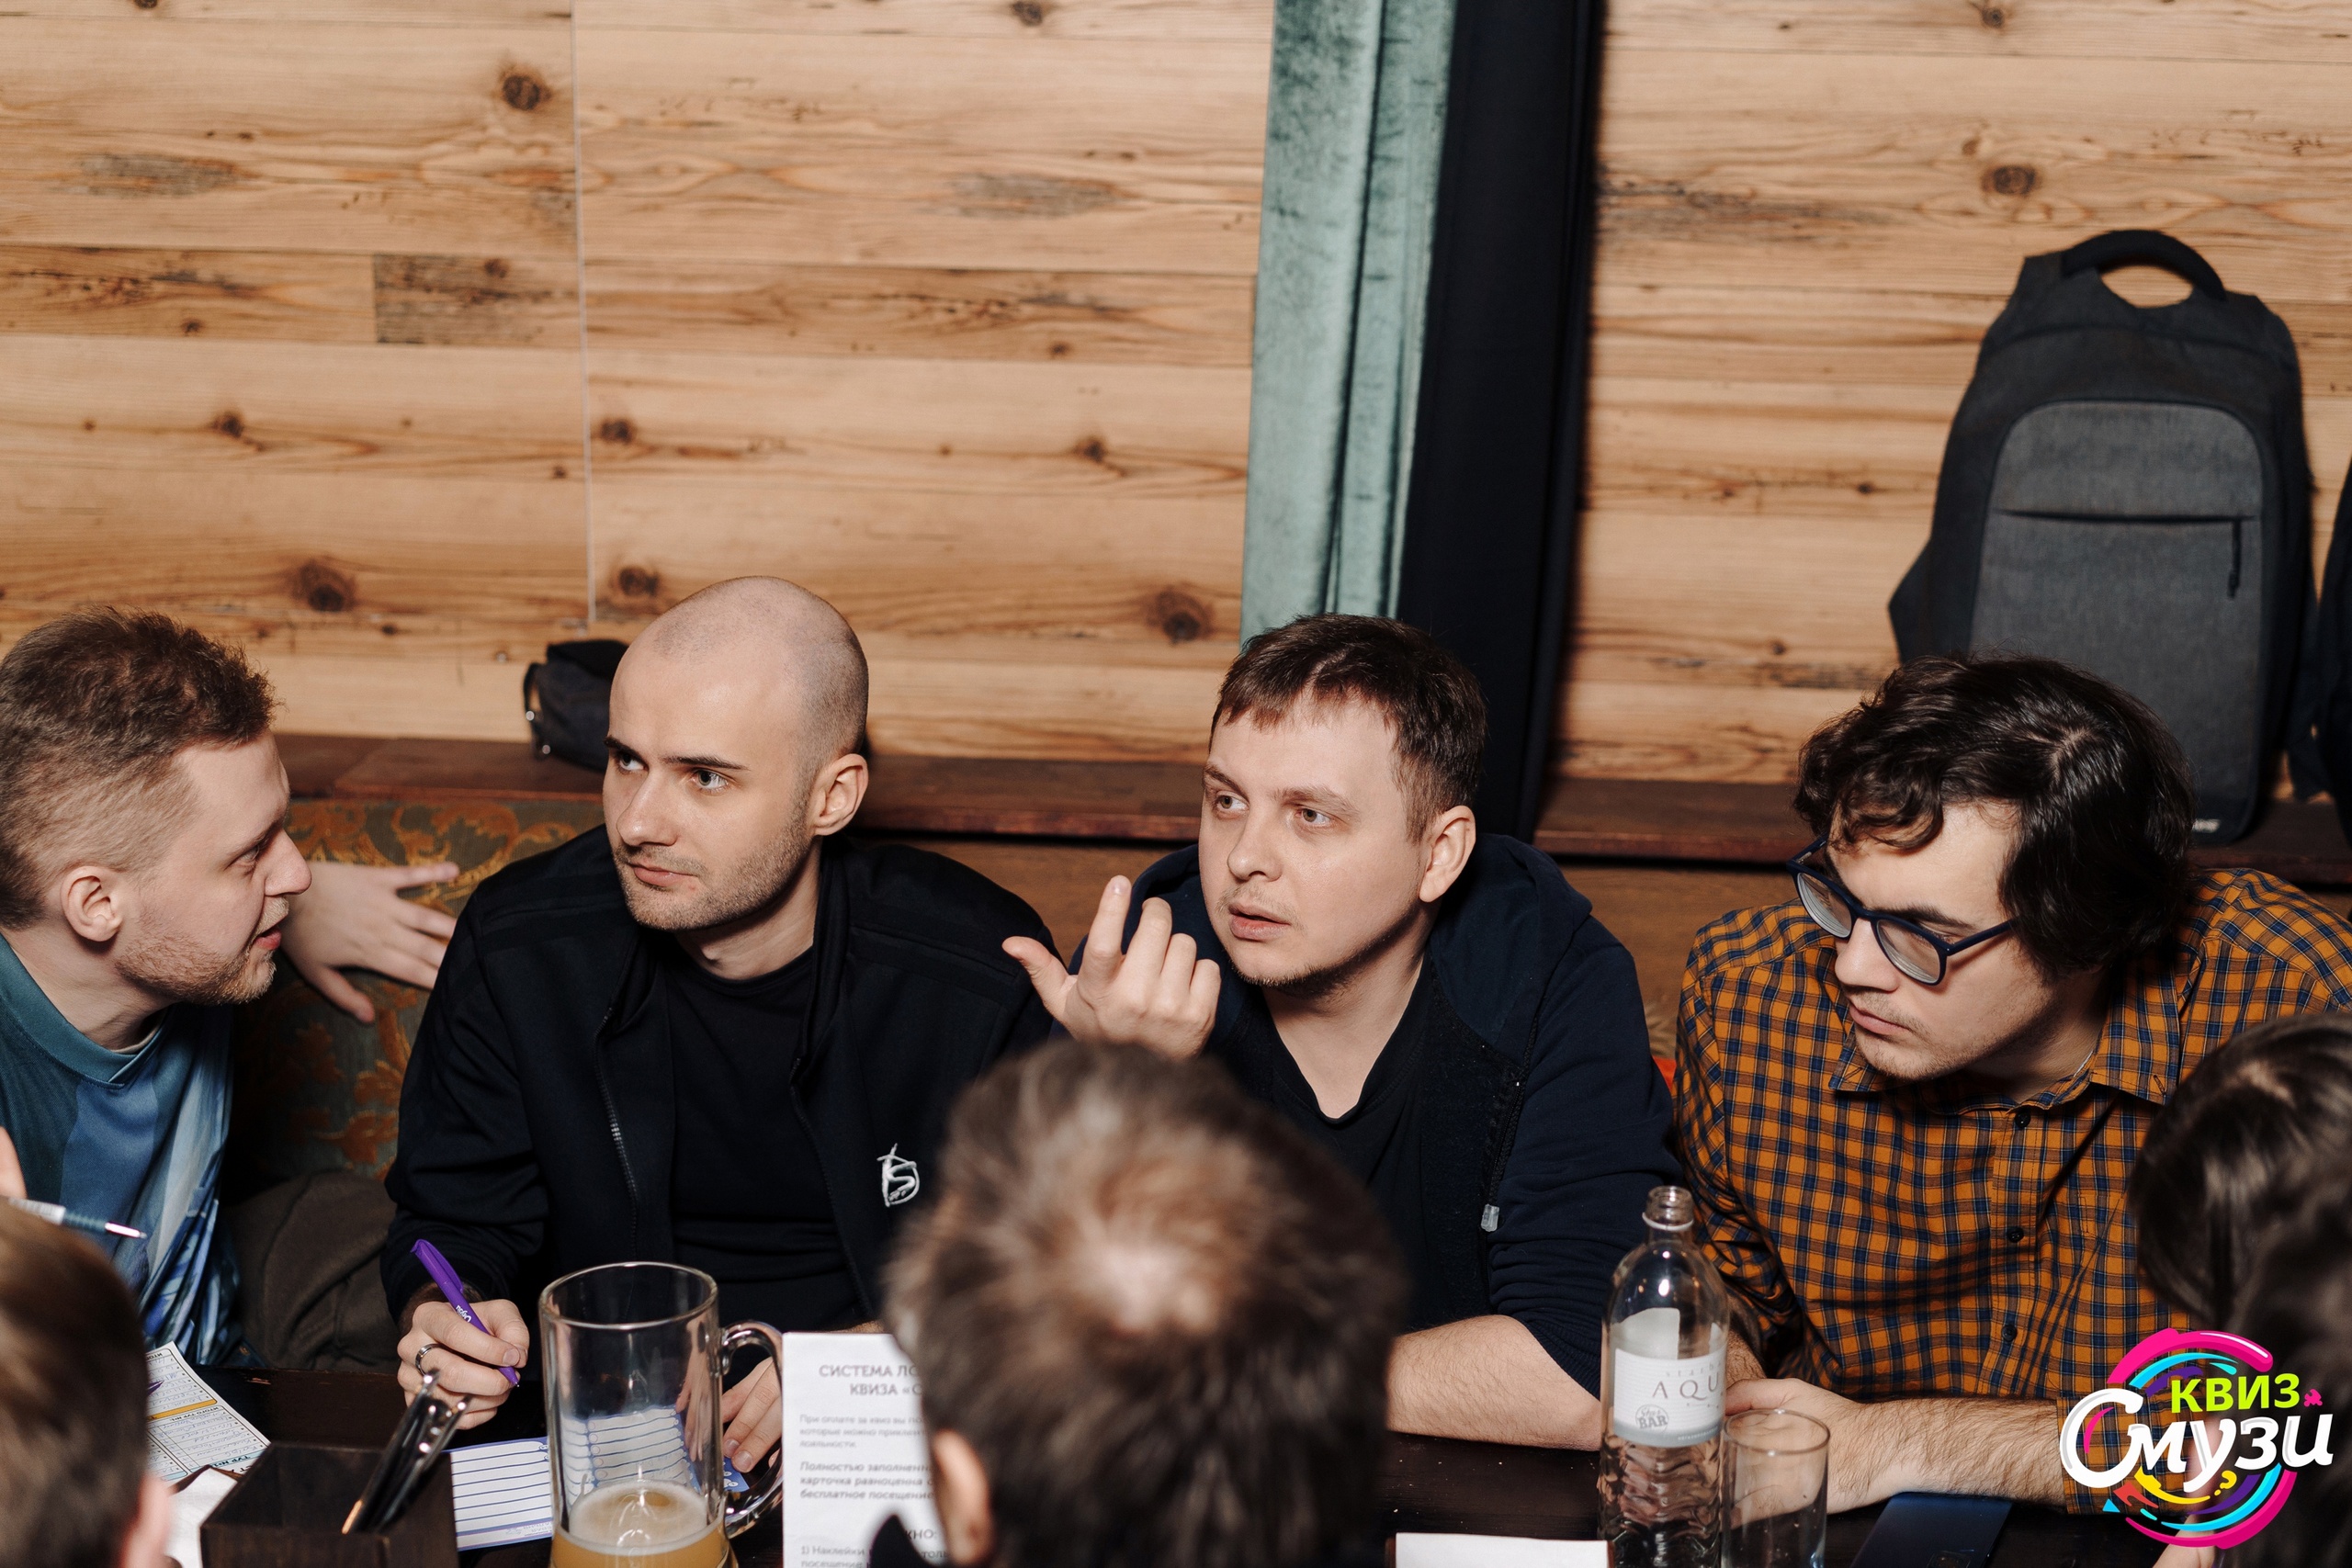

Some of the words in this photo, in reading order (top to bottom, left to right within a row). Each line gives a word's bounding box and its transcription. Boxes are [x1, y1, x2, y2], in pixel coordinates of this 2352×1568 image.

[819, 1365, 893, 1377] СИСТЕМА
[850, 1383, 898, 1395] КВИЗА
[1652, 1371, 1718, 1401] AQU
[799, 1415, 820, 1425] При
[821, 1416, 856, 1425] оплате
[1637, 1415, 1668, 1429] BAR
[800, 1461, 865, 1472] Полностью
[800, 1477, 852, 1486] карточка
[854, 1477, 923, 1487] равноценна
[800, 1488, 866, 1499] бесплатное
[812, 1545, 865, 1556] Наклейки
